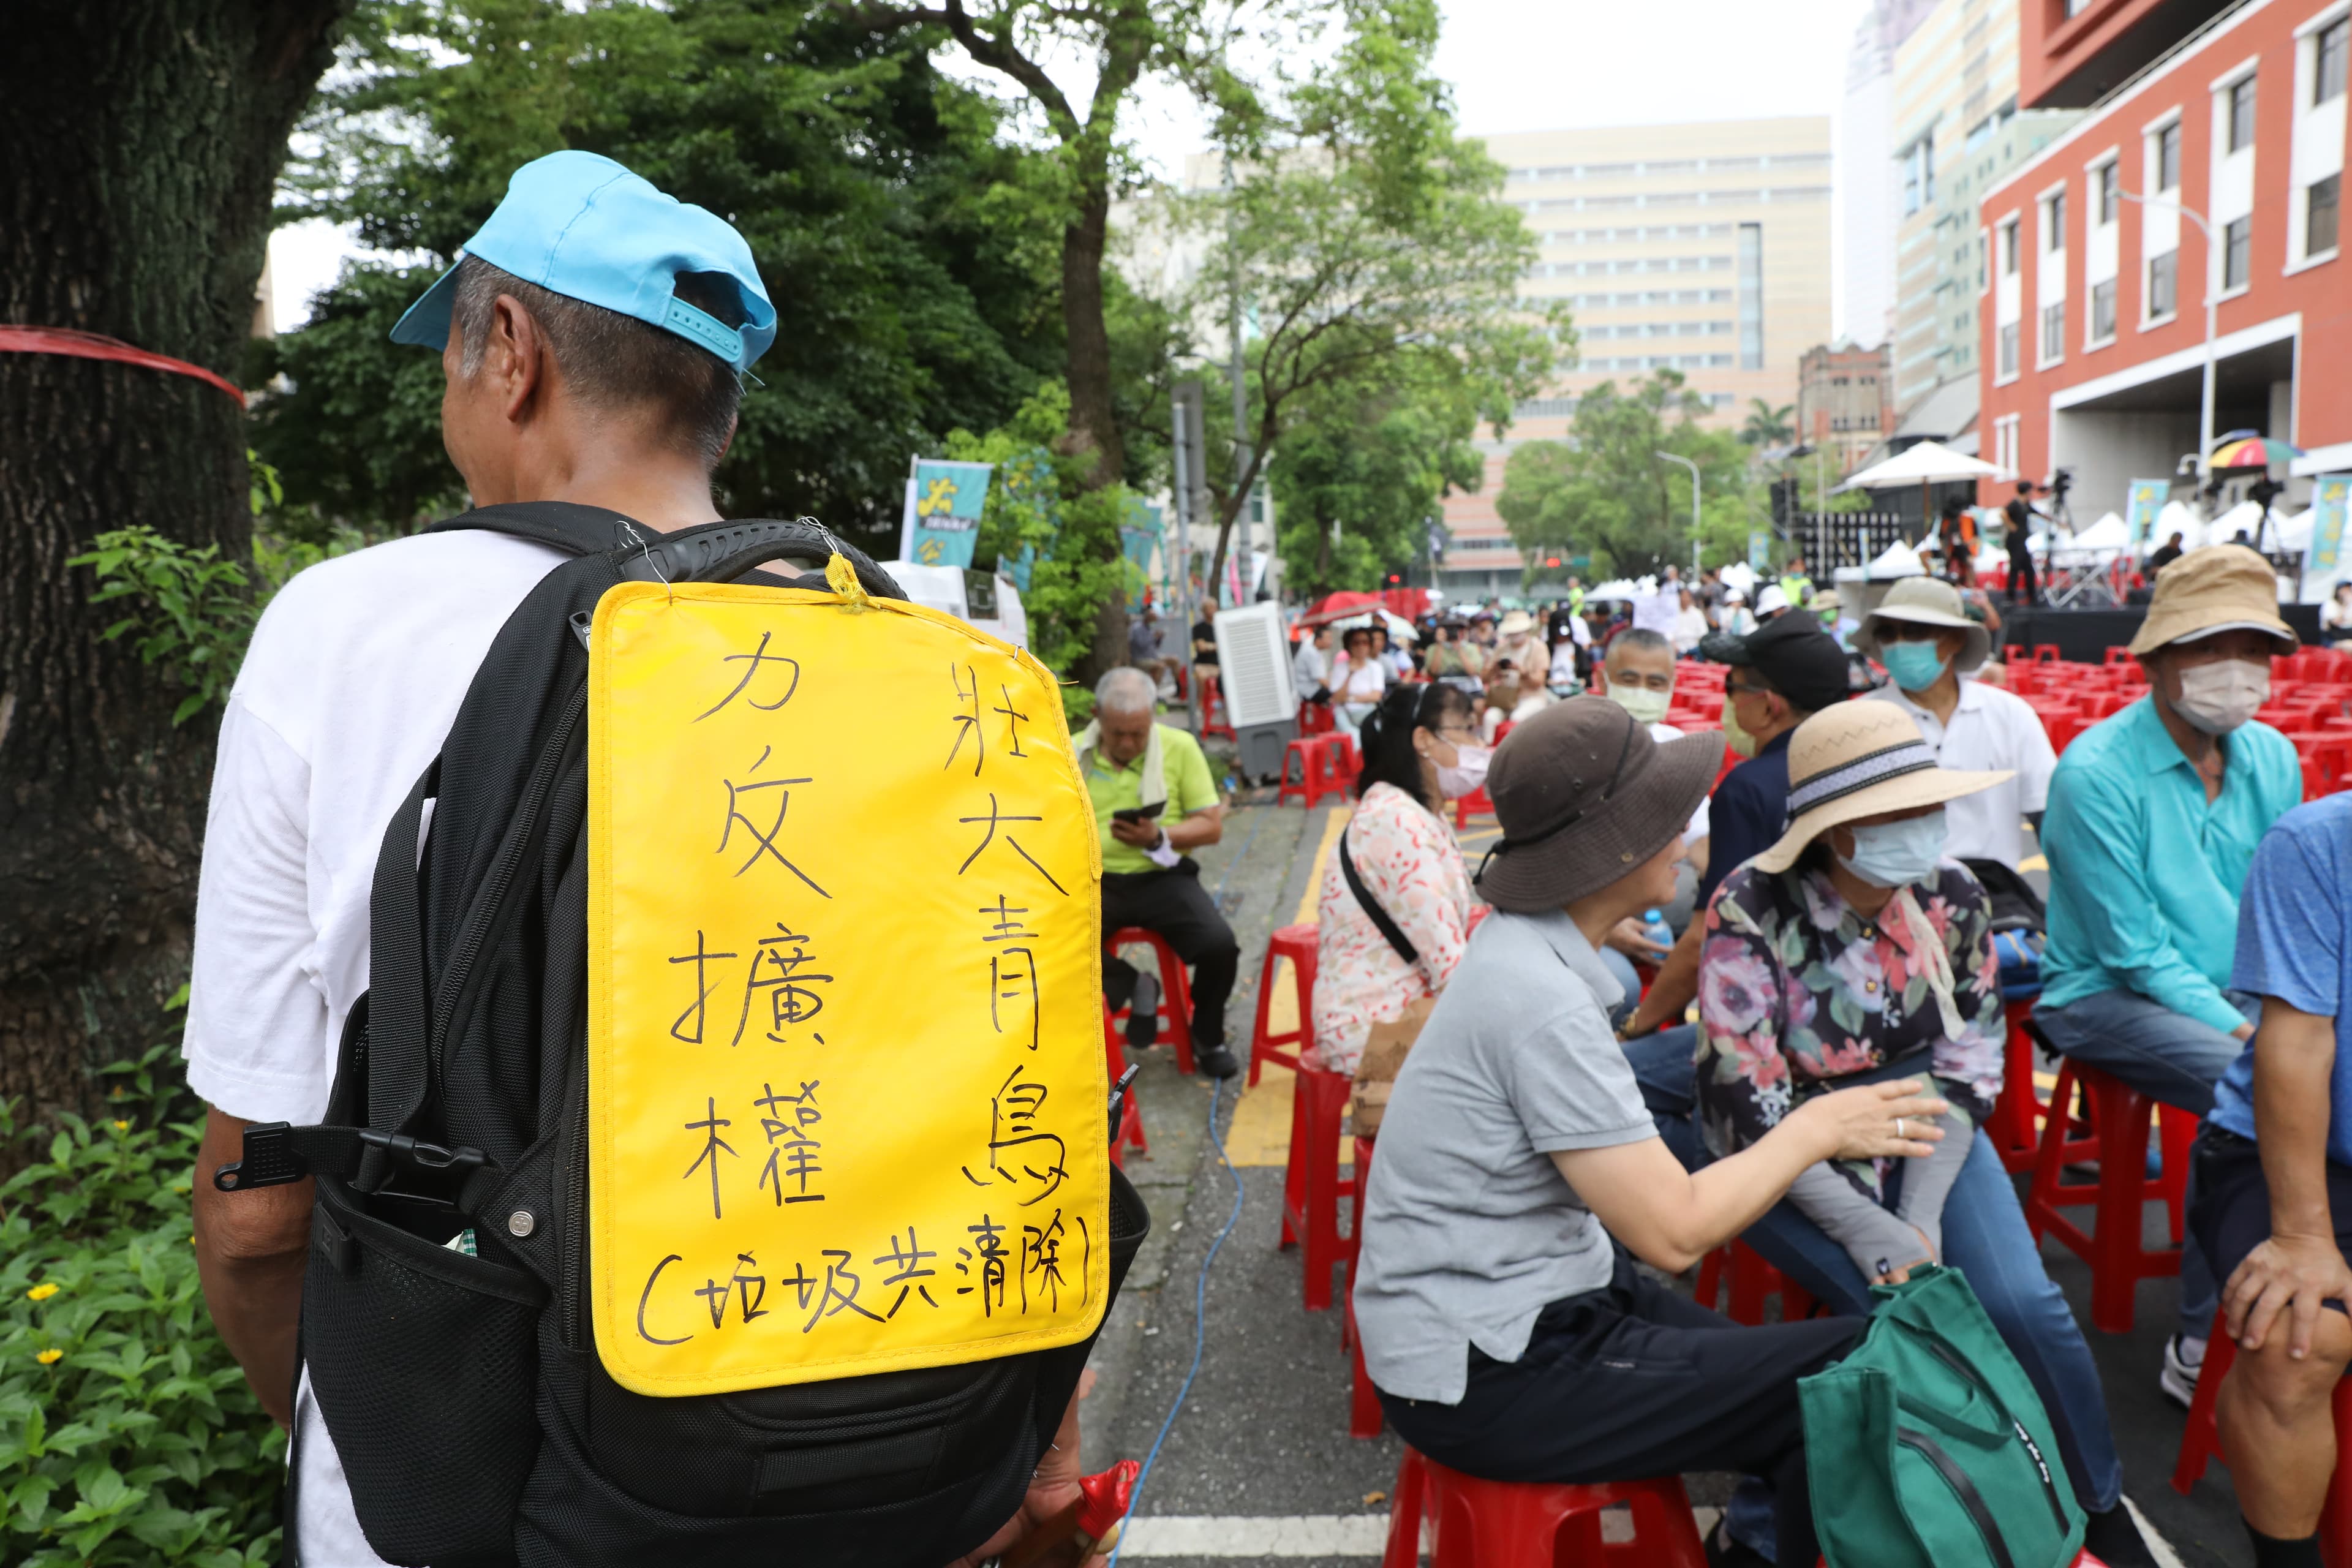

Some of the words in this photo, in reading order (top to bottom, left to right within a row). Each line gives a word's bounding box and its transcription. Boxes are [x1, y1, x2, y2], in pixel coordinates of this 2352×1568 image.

[668, 631, 834, 1219] 力反擴權
[944, 662, 1071, 1206] 壯大青鳥
